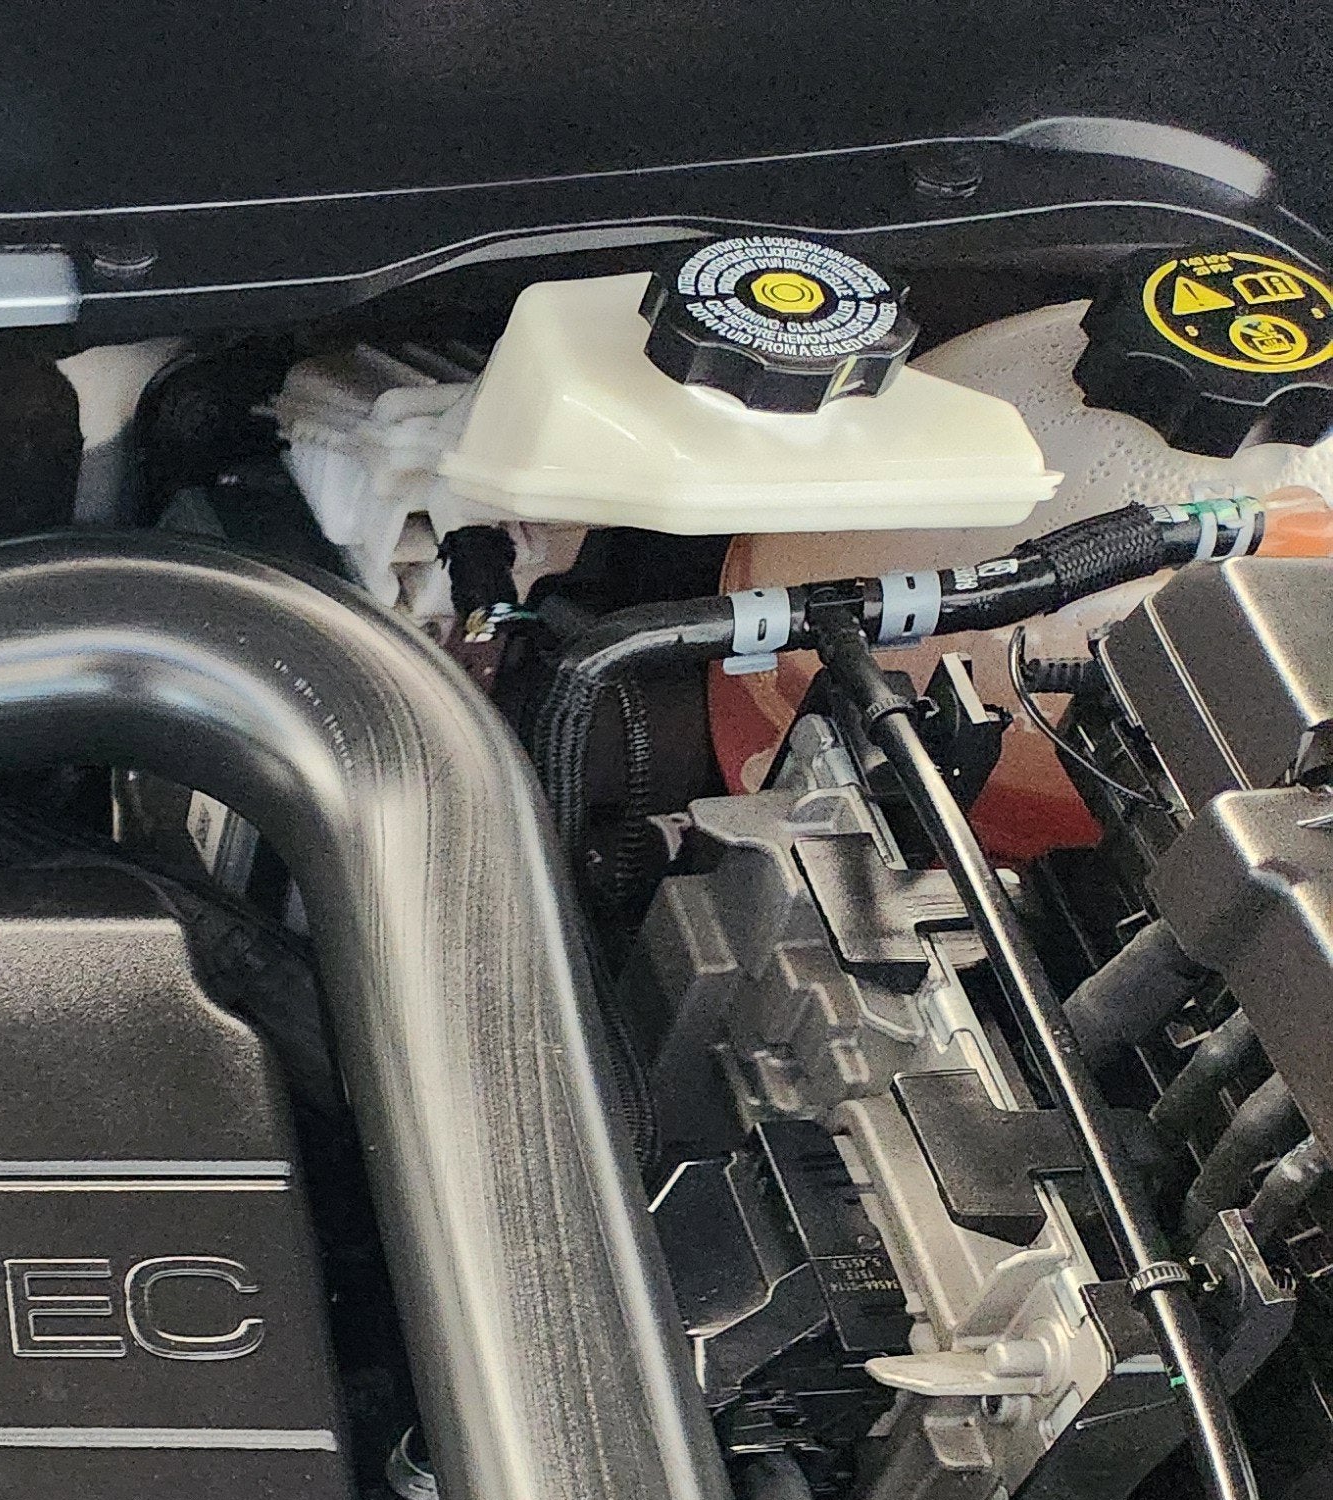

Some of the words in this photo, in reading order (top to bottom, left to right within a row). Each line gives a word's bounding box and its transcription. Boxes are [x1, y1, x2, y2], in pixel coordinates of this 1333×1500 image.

[743, 247, 763, 257] DU
[761, 247, 809, 259] LIQUIDE
[806, 253, 827, 265] DE
[744, 236, 762, 246] LE
[762, 237, 822, 252] BOUCHON
[818, 246, 861, 267] AVANT
[783, 259, 821, 274] BIDON
[704, 300, 732, 318] CAP
[722, 315, 776, 340] BEFORE
[786, 318, 835, 332] CLEAN
[711, 321, 753, 345] FLUID
[752, 338, 797, 355] FROM
[798, 346, 810, 354] A
[809, 337, 865, 356] SEALED
